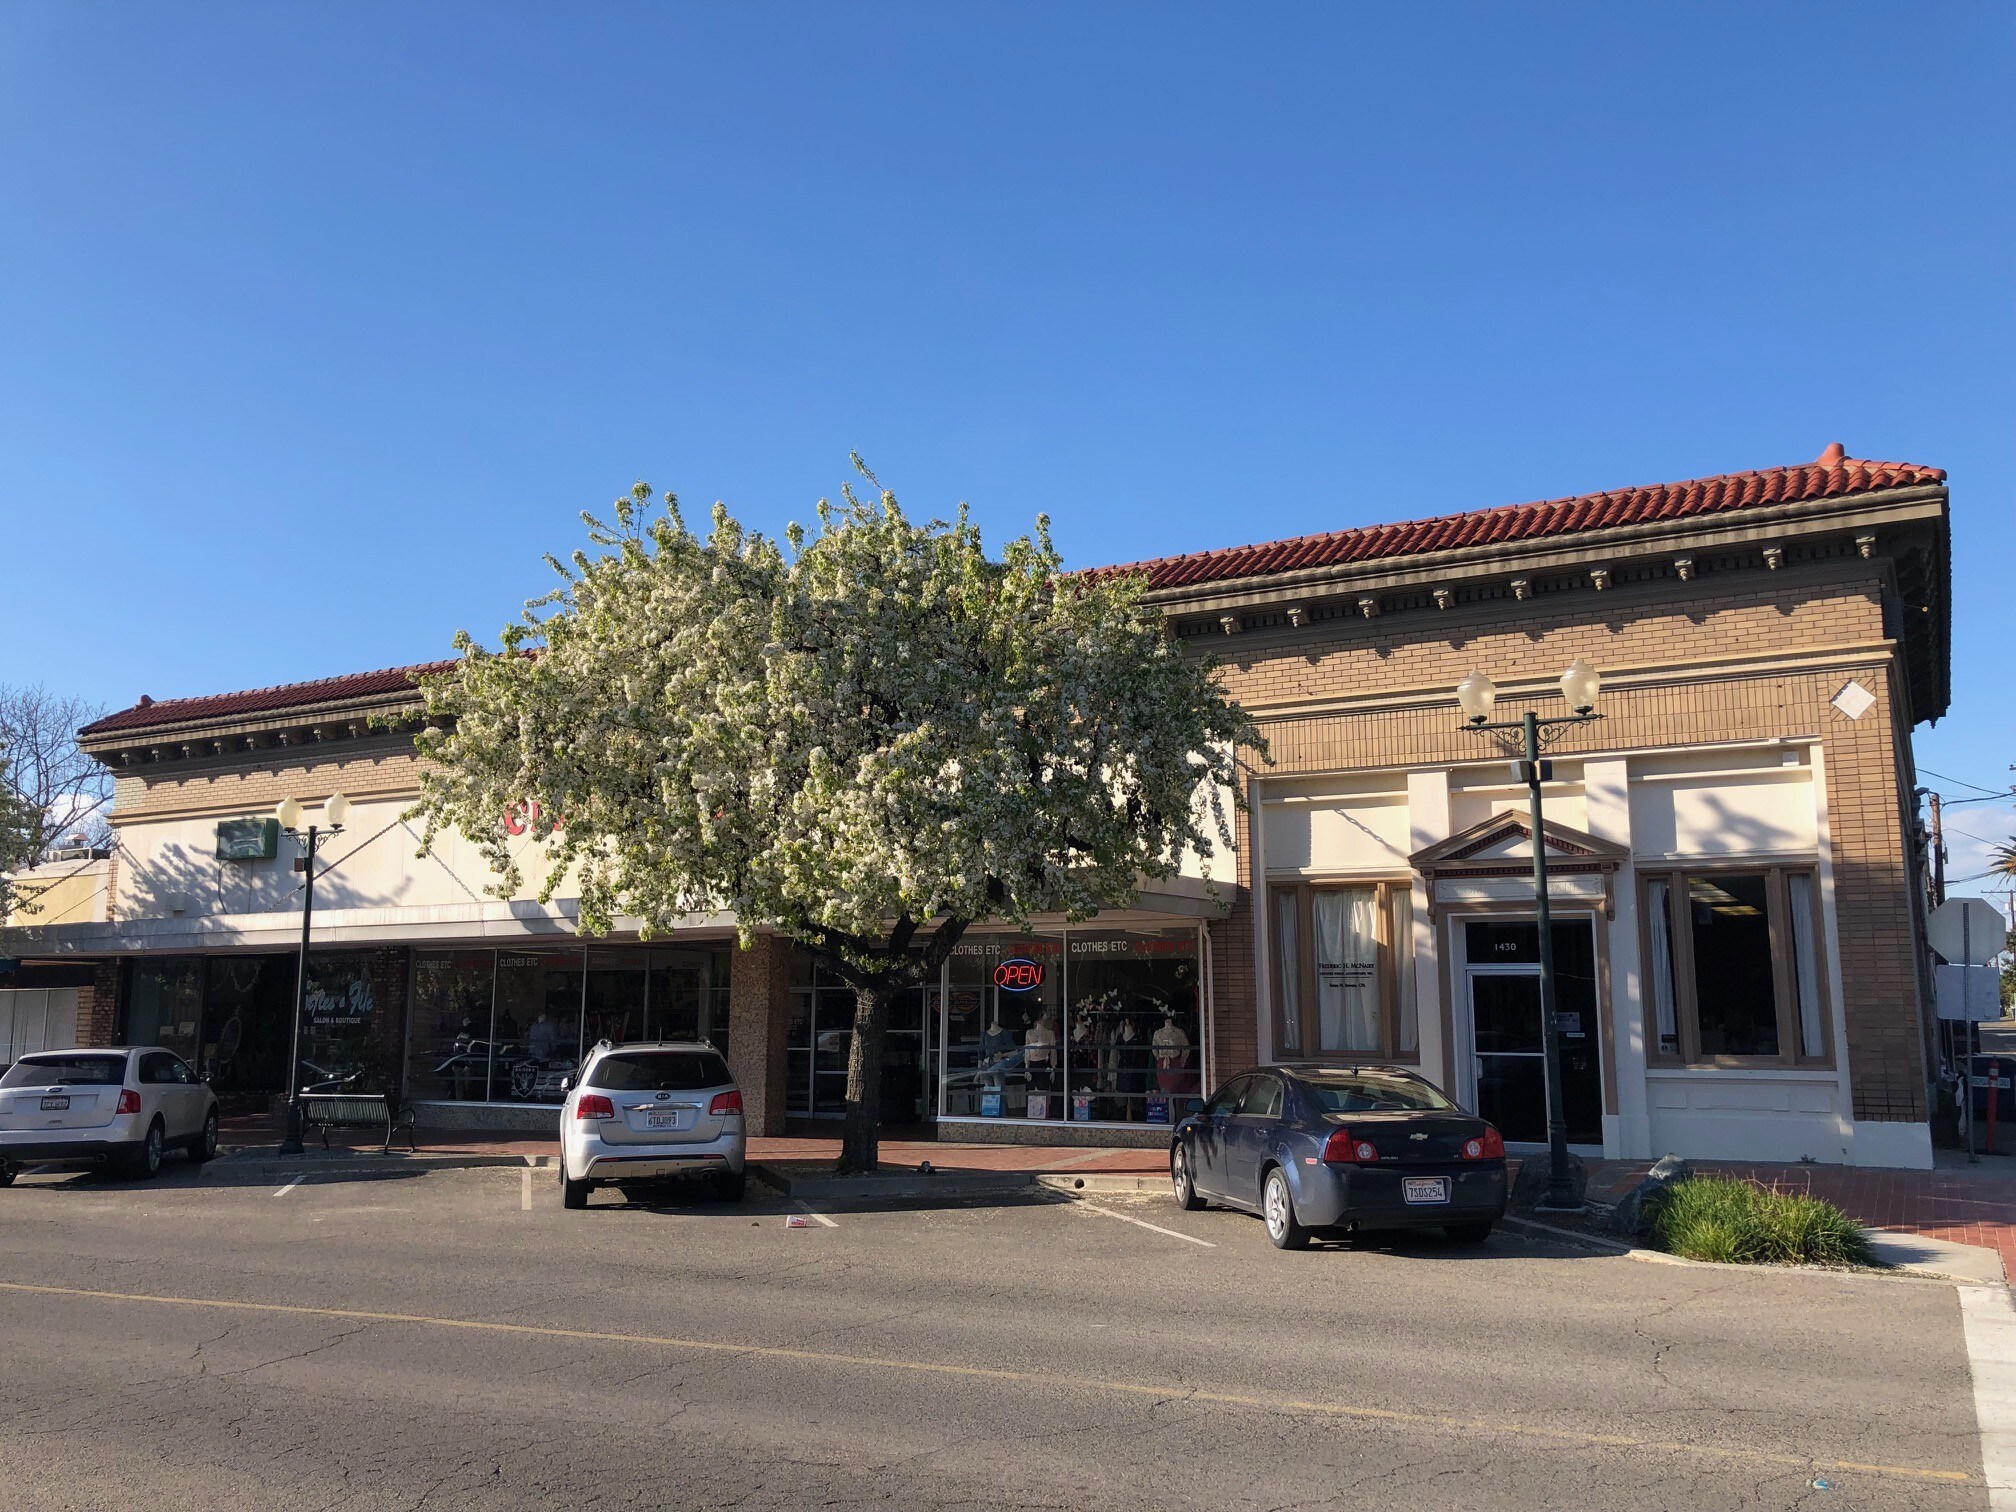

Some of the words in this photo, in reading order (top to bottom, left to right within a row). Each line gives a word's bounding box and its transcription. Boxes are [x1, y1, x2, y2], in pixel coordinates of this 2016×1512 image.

[949, 945, 983, 955] CLOTHES
[985, 944, 1001, 955] ETC
[1071, 941, 1108, 953] CLOTHES
[1111, 940, 1128, 952] ETC
[1494, 942, 1517, 951] 1430
[415, 960, 440, 969] CLOTHES
[440, 960, 452, 969] ETC
[499, 957, 526, 967] CLOTHES
[526, 957, 538, 967] ETC
[993, 965, 1043, 985] OPEN
[1408, 1187, 1443, 1198] 7SDS254
